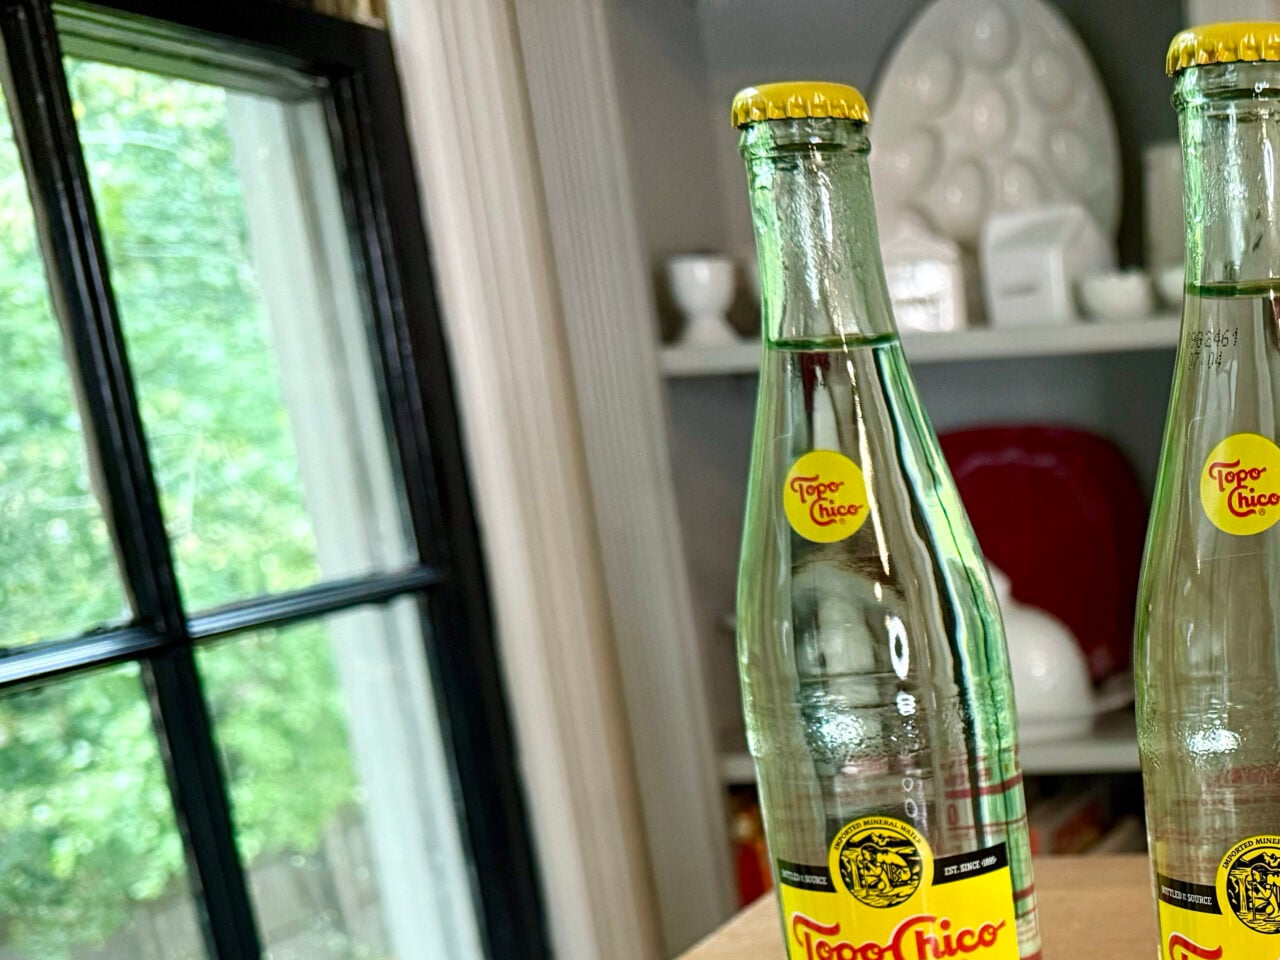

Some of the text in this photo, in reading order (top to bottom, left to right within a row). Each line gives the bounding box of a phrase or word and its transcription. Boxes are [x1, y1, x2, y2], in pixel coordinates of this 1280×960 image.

[790, 474, 844, 504] Topo
[1208, 459, 1267, 492] Topo
[809, 497, 864, 527] Chico
[1222, 840, 1254, 869] IMPORTED
[944, 864, 960, 876] EST.
[1187, 893, 1213, 905] SOURCE
